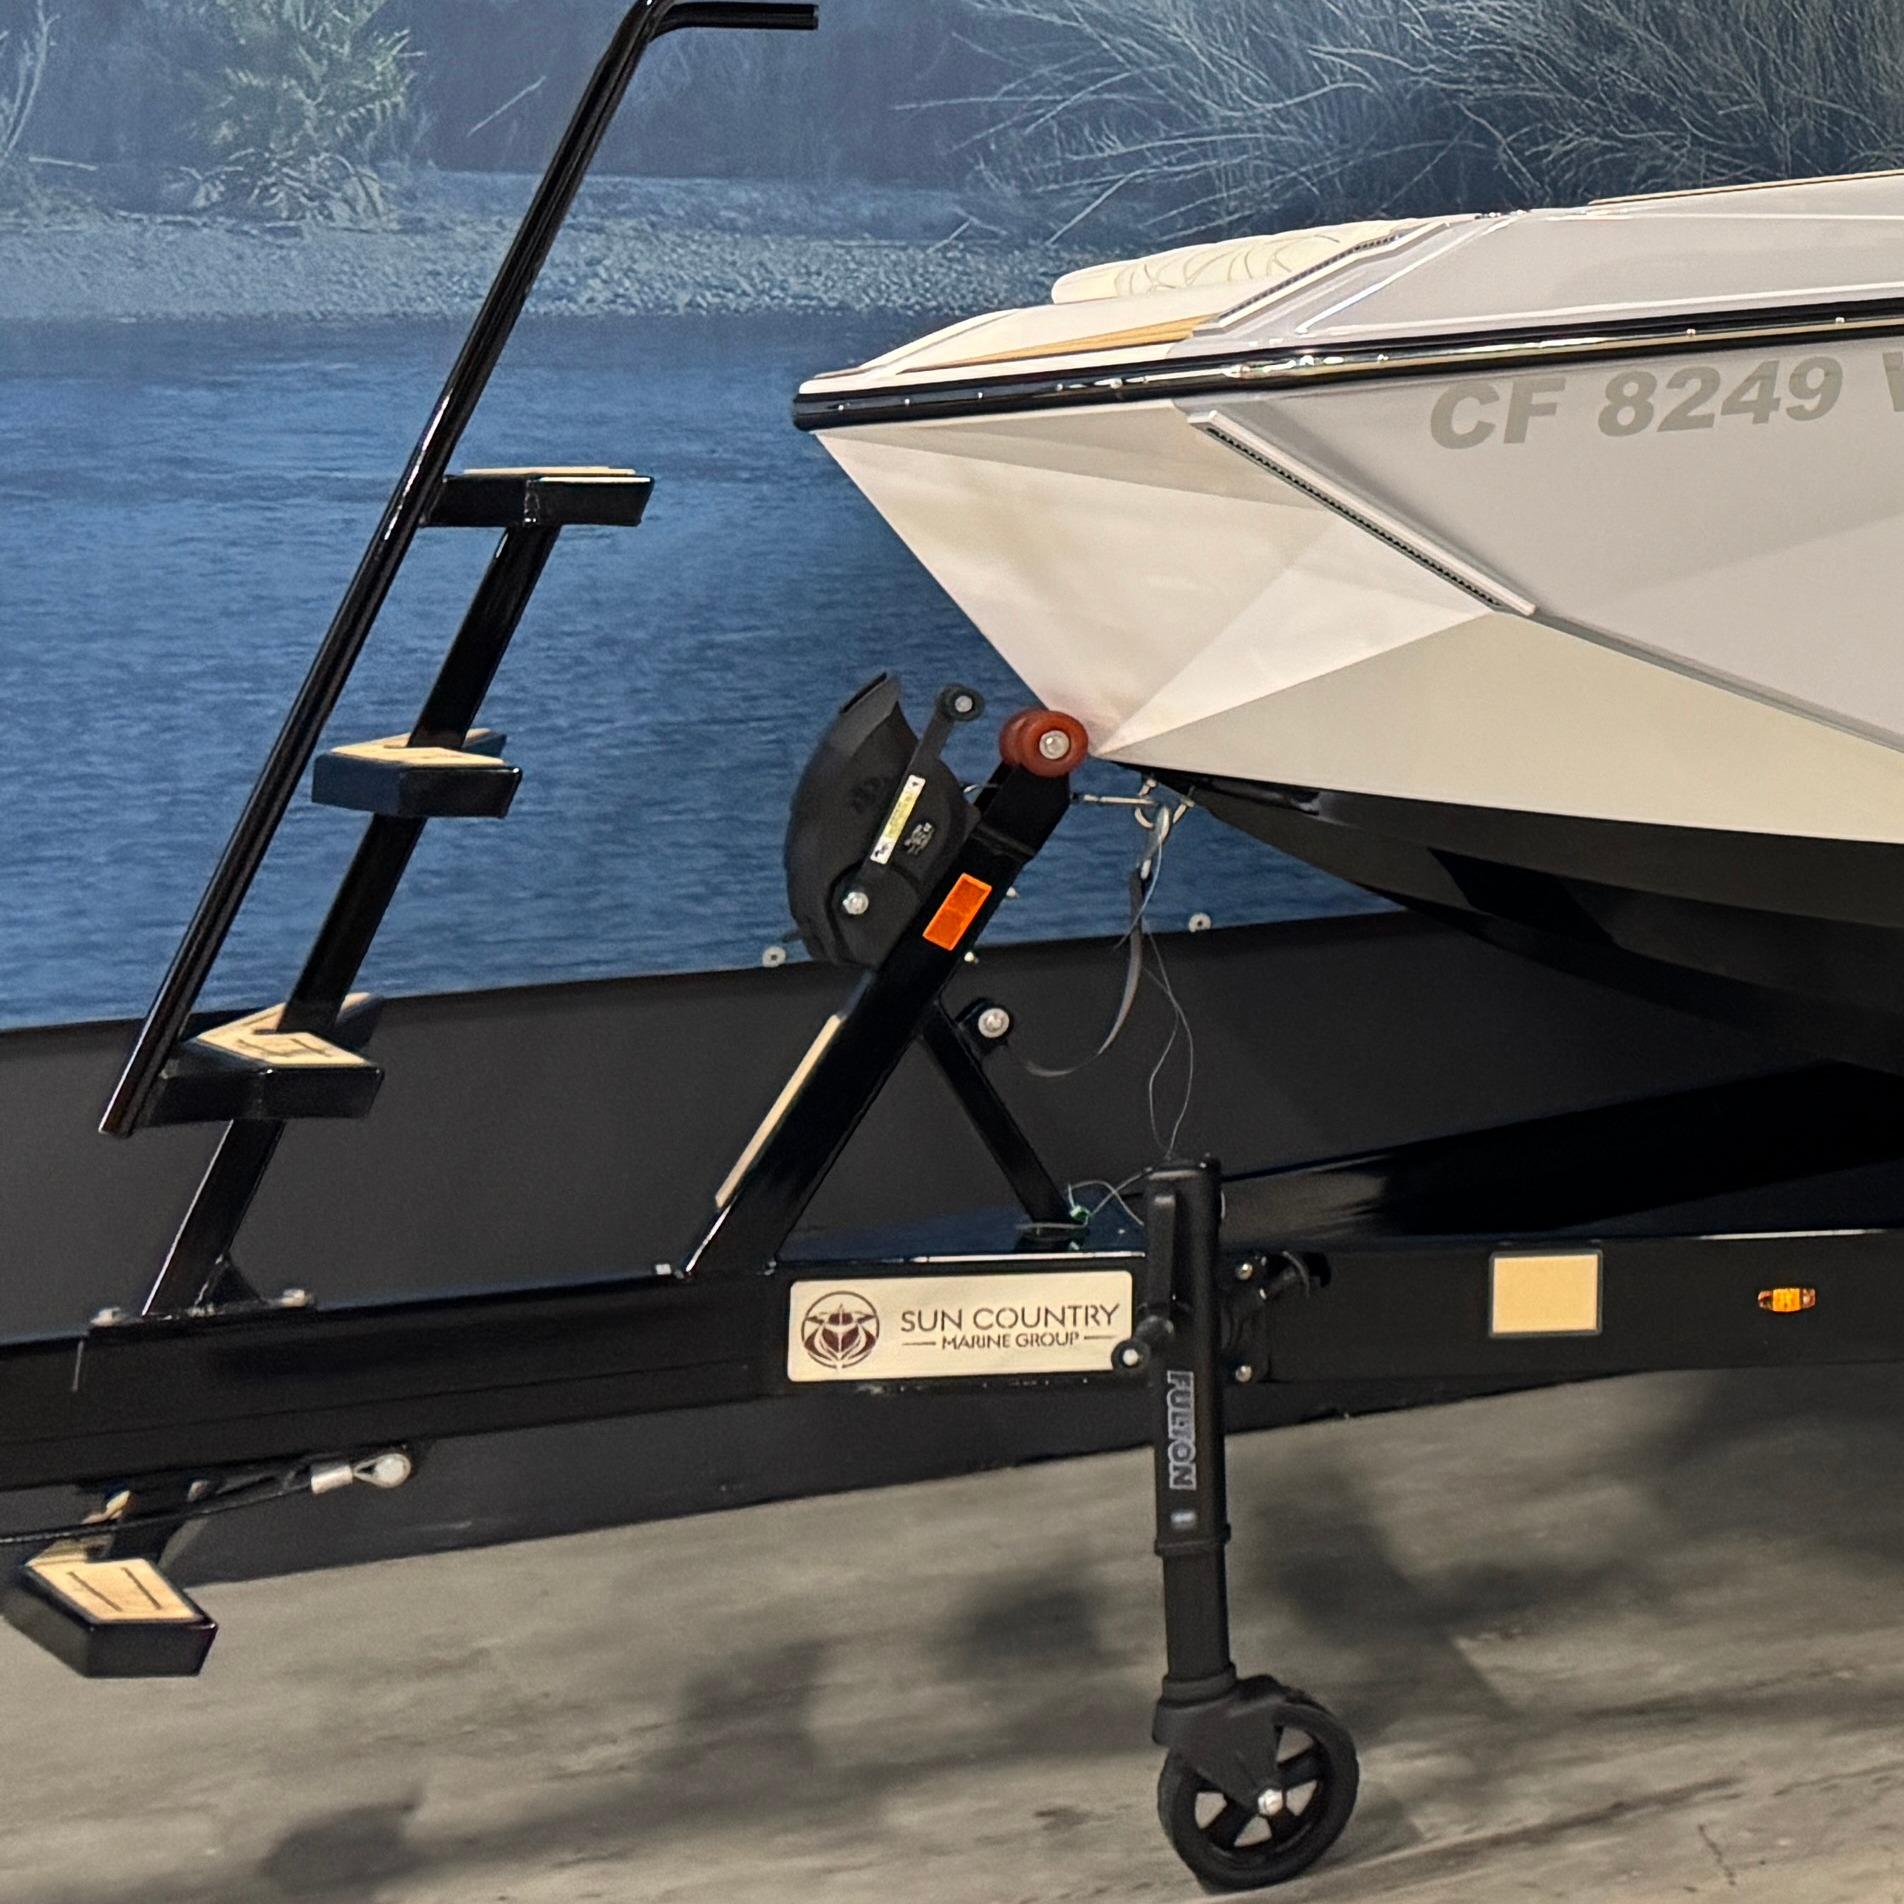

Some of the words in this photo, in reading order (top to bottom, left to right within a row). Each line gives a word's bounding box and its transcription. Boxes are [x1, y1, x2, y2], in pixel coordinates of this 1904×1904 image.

[1429, 376, 1566, 450] CF
[1598, 357, 1846, 438] 8249
[900, 1308, 963, 1333] SUN
[972, 1302, 1121, 1331] COUNTRY
[941, 1333, 1011, 1351] MARINE
[1015, 1331, 1080, 1348] GROUP
[1166, 1369, 1197, 1491] FULTON
